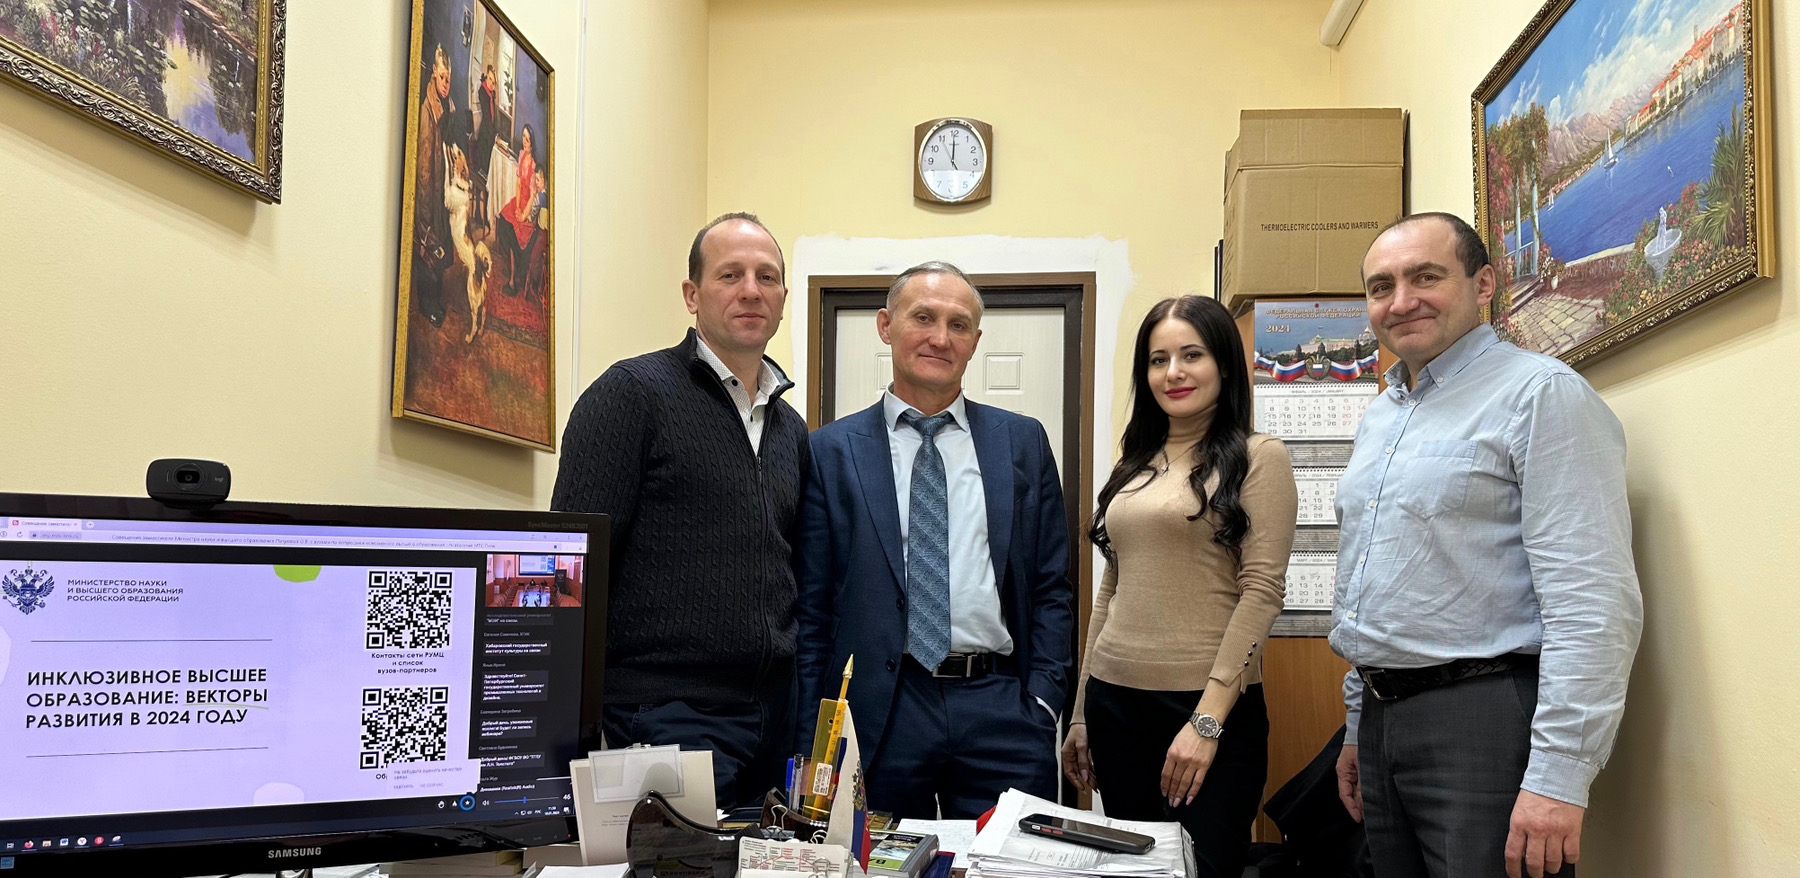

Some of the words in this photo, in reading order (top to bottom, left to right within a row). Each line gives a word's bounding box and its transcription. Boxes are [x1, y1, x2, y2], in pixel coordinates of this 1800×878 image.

[931, 145, 939, 153] 10
[928, 157, 934, 165] 9
[972, 158, 978, 166] 3
[962, 181, 968, 189] 5
[1261, 223, 1311, 231] THERMOELECTRIC
[1310, 223, 1337, 231] COOLERS
[1338, 222, 1350, 230] AND
[1350, 221, 1379, 229] WARMERS
[1266, 324, 1291, 333] 2024
[127, 595, 179, 603] ФЕДЕРАЦИИ
[27, 670, 181, 686] ИНКЛЮЗИВНОЕ
[187, 669, 267, 683] ВЫСШЕЕ
[26, 690, 179, 707] ОБРАЗОВАНИЕ:
[186, 689, 268, 704] ВЕКТОРЫ
[26, 712, 123, 728] РАЗВИТИЯ
[130, 712, 141, 726] В
[146, 710, 190, 725] 2024
[197, 709, 248, 724] ГОДУ
[268, 847, 322, 858] SAMSUNG
